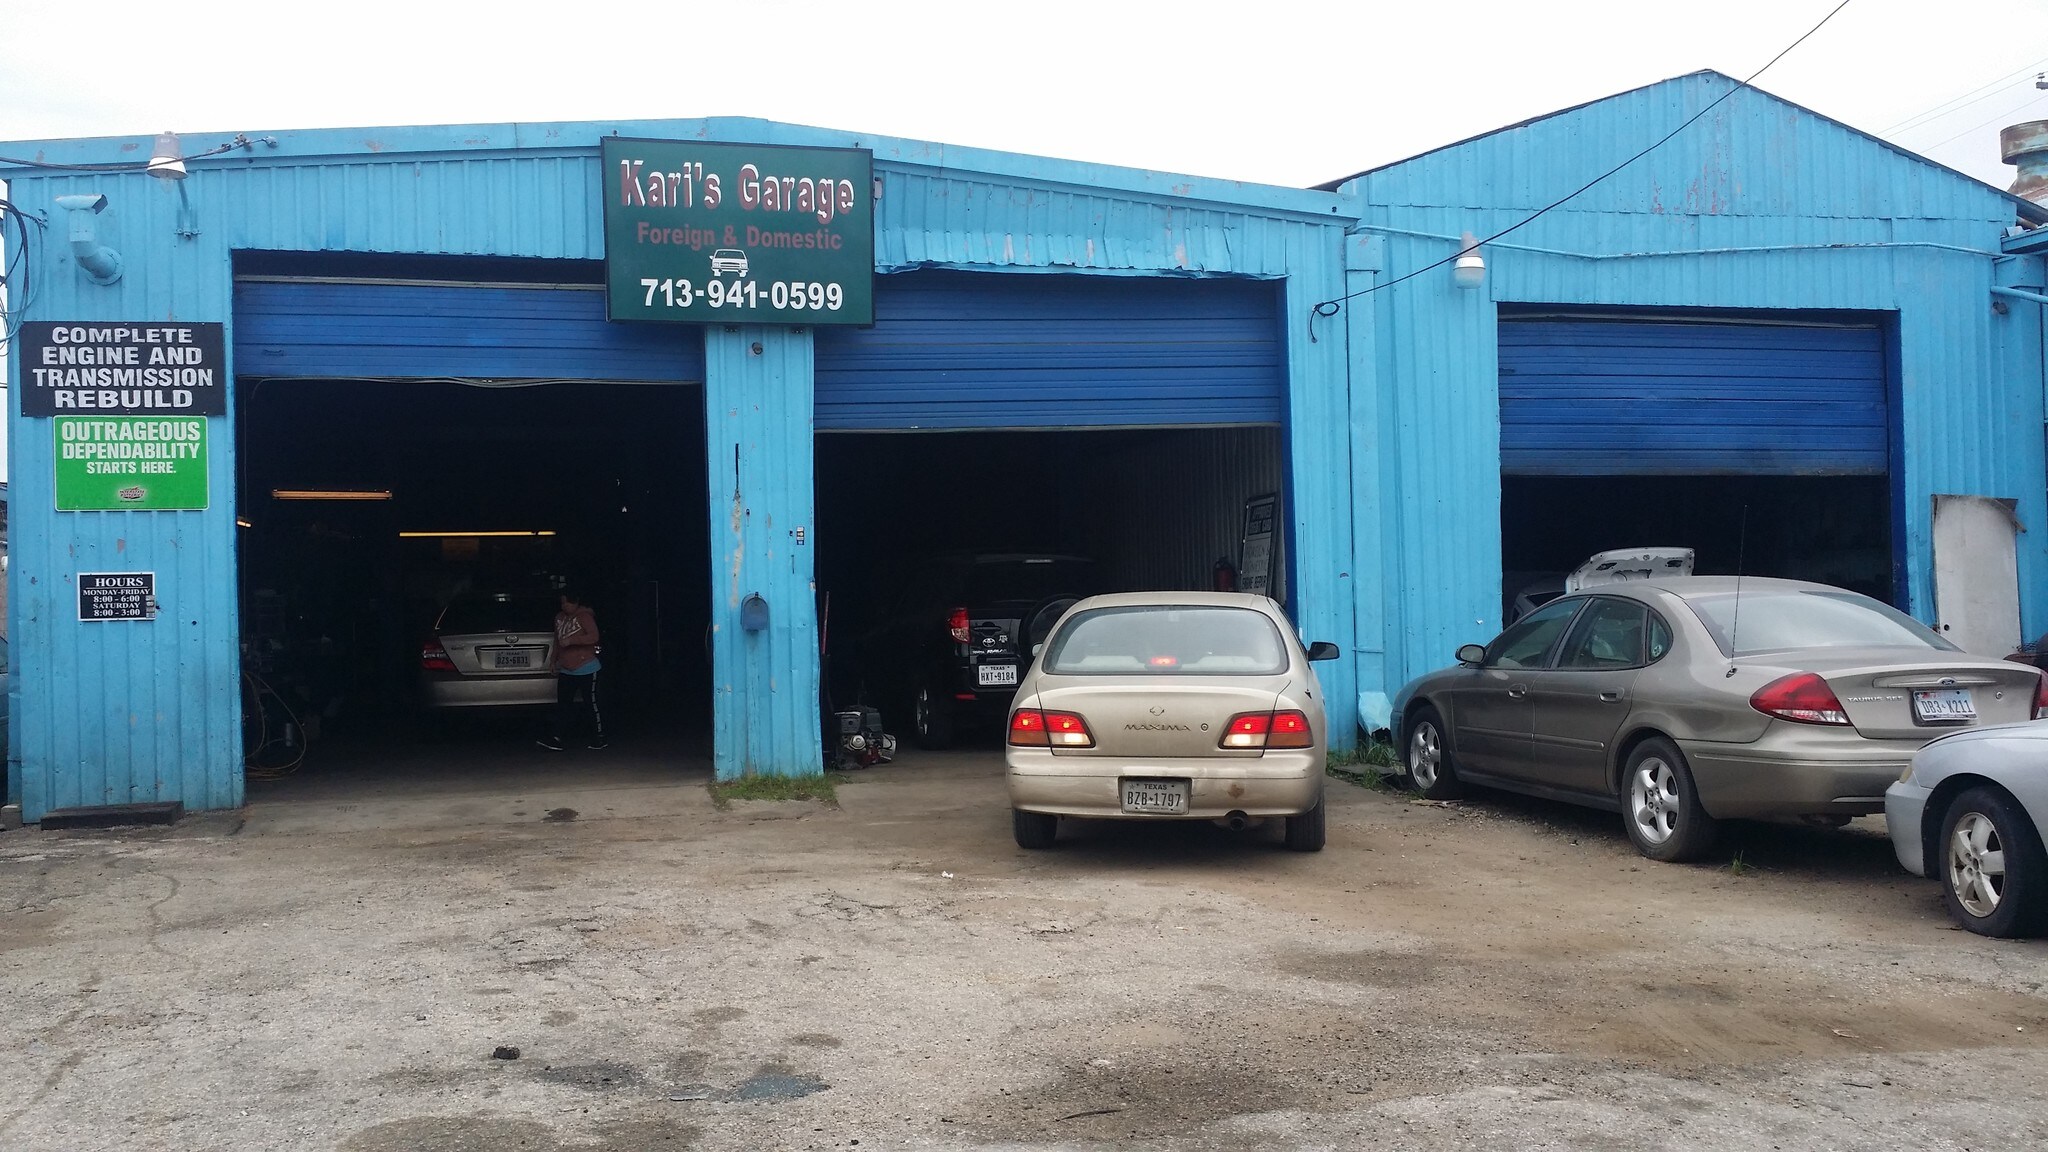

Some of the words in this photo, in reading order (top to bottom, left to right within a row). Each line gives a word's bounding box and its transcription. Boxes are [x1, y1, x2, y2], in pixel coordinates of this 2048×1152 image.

[738, 163, 855, 225] Garage
[637, 221, 716, 250] Foreign
[723, 225, 738, 246] &
[746, 225, 843, 250] Domestic
[640, 278, 843, 311] 713-941-0599
[52, 326, 193, 344] COMPLETE
[42, 346, 140, 365] ENGINE
[148, 347, 203, 365] AND
[32, 368, 214, 387] TRANSMISSION
[54, 390, 193, 409] REBUILD
[61, 421, 201, 441] OUTRAGEOUS
[62, 442, 201, 460] DEPENDABILITY
[86, 461, 137, 474] STARTS
[141, 461, 177, 474] HERE.
[95, 577, 144, 587] HOURS
